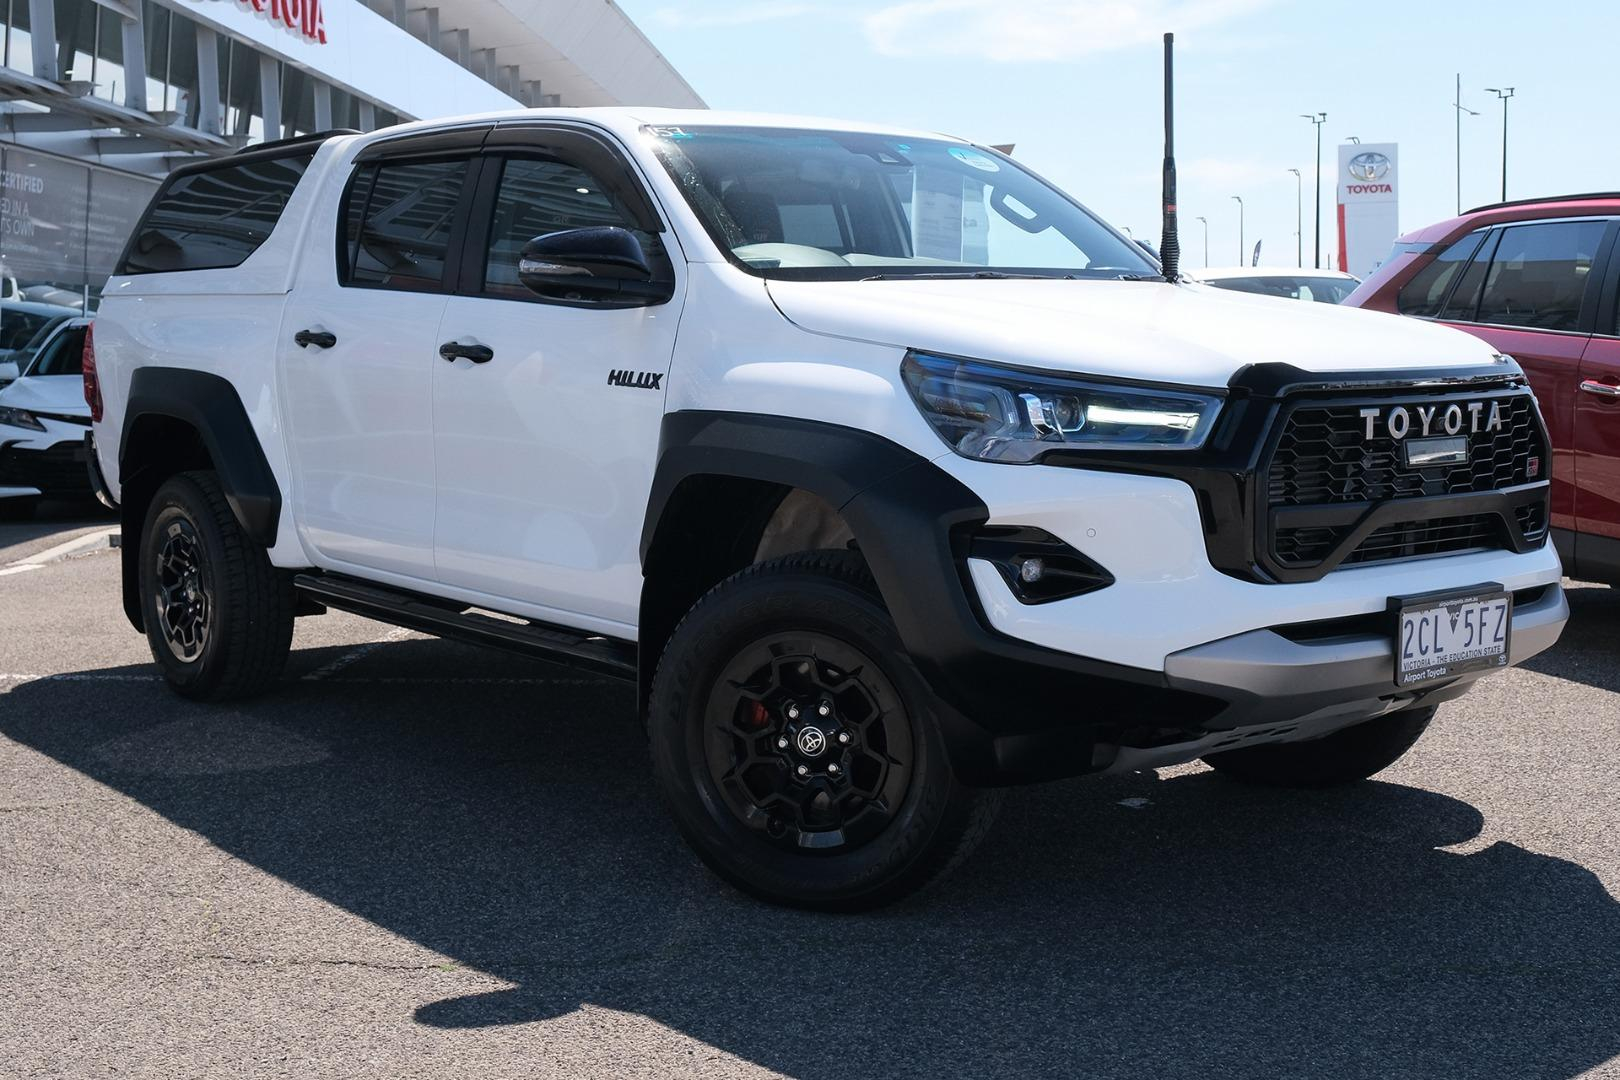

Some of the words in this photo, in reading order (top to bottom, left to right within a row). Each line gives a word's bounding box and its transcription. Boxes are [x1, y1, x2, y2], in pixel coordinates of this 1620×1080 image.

[1346, 184, 1392, 195] TOYOTA
[607, 369, 664, 390] HILUX
[1360, 400, 1503, 440] TOYOTA
[1403, 615, 1444, 659] 2CL
[1464, 605, 1506, 647] 5FZ
[1403, 658, 1431, 670] VICTORIA
[1436, 655, 1448, 664] THE
[1449, 649, 1482, 661] EDUCATION
[1483, 645, 1501, 656] STATE
[1403, 670, 1426, 684] Airport
[1427, 667, 1447, 680] Toyota
